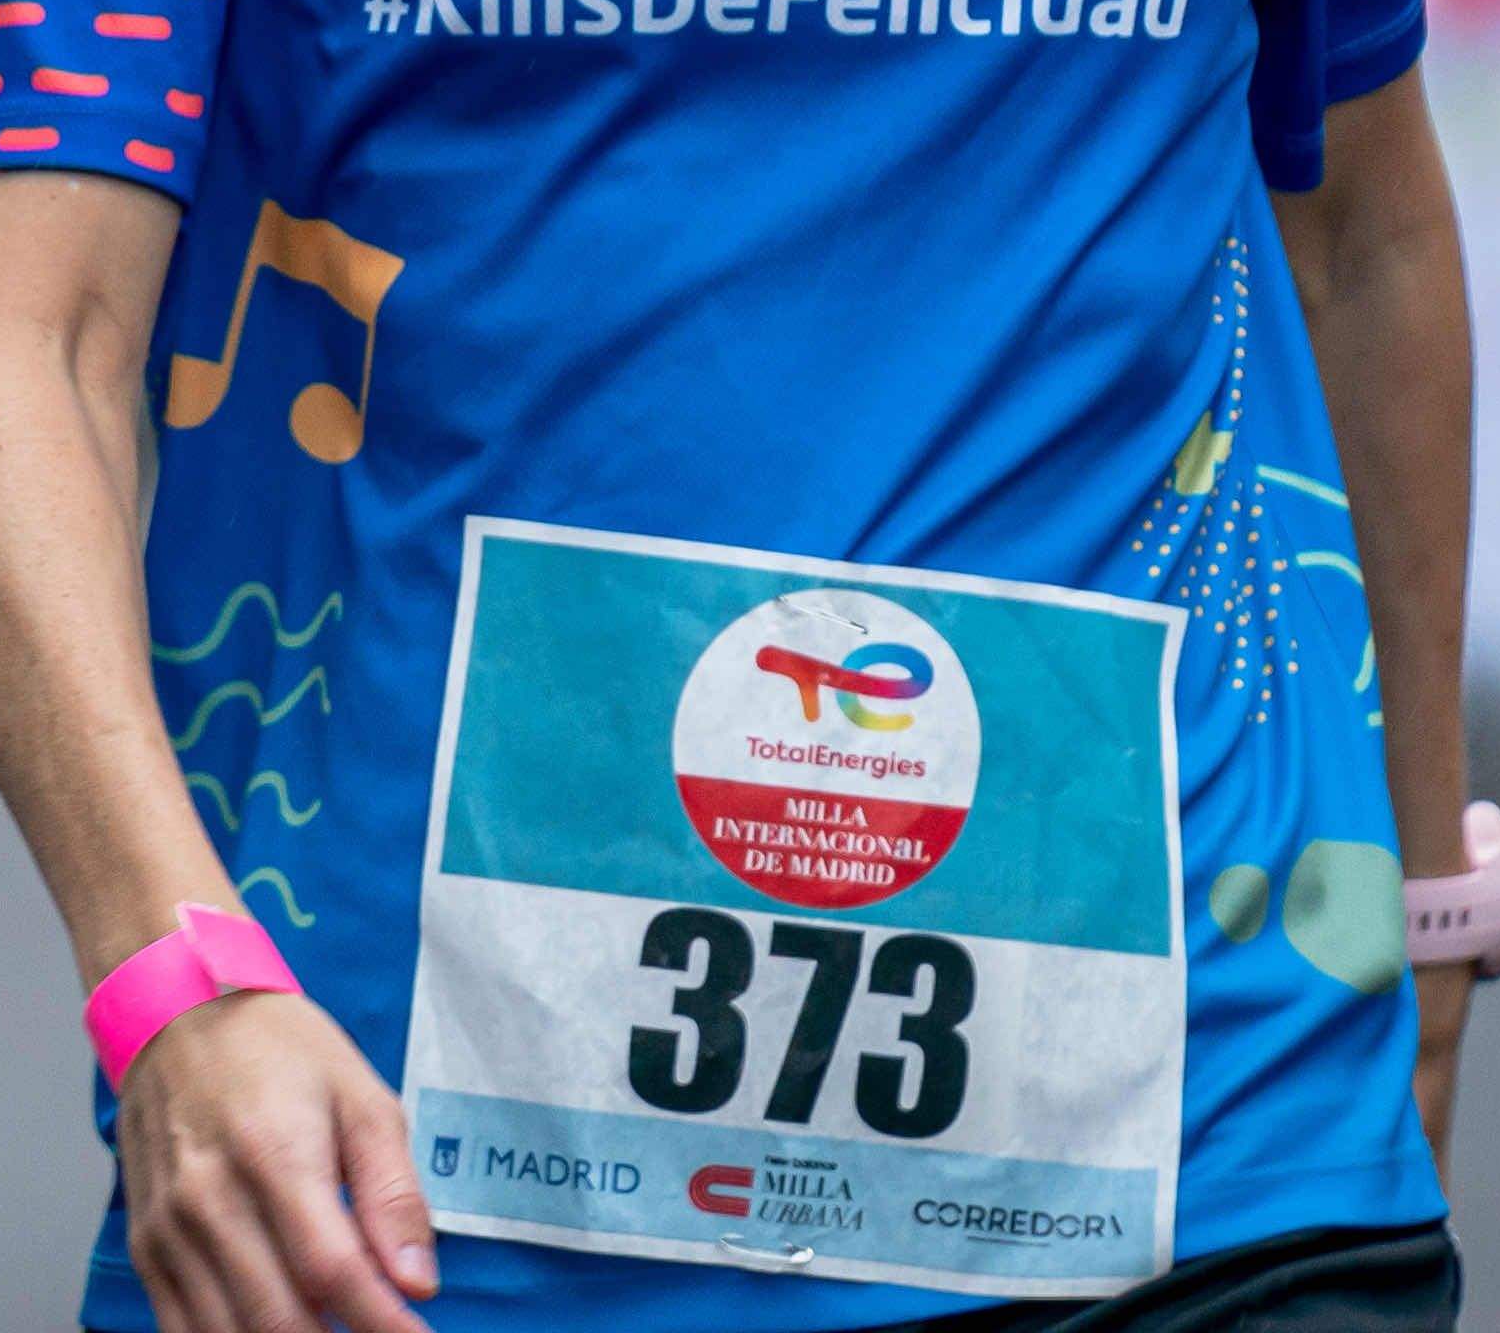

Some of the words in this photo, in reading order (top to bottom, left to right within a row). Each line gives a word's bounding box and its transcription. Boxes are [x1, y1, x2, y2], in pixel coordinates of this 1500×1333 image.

[745, 735, 927, 780] TotalEnergies
[783, 796, 869, 828] MILLA
[743, 848, 785, 875] DE
[788, 852, 897, 887] MADRID
[627, 906, 979, 1140] 373
[485, 1145, 642, 1195] MADRID
[764, 1171, 855, 1202] MILLA
[757, 1199, 864, 1232] URBANA
